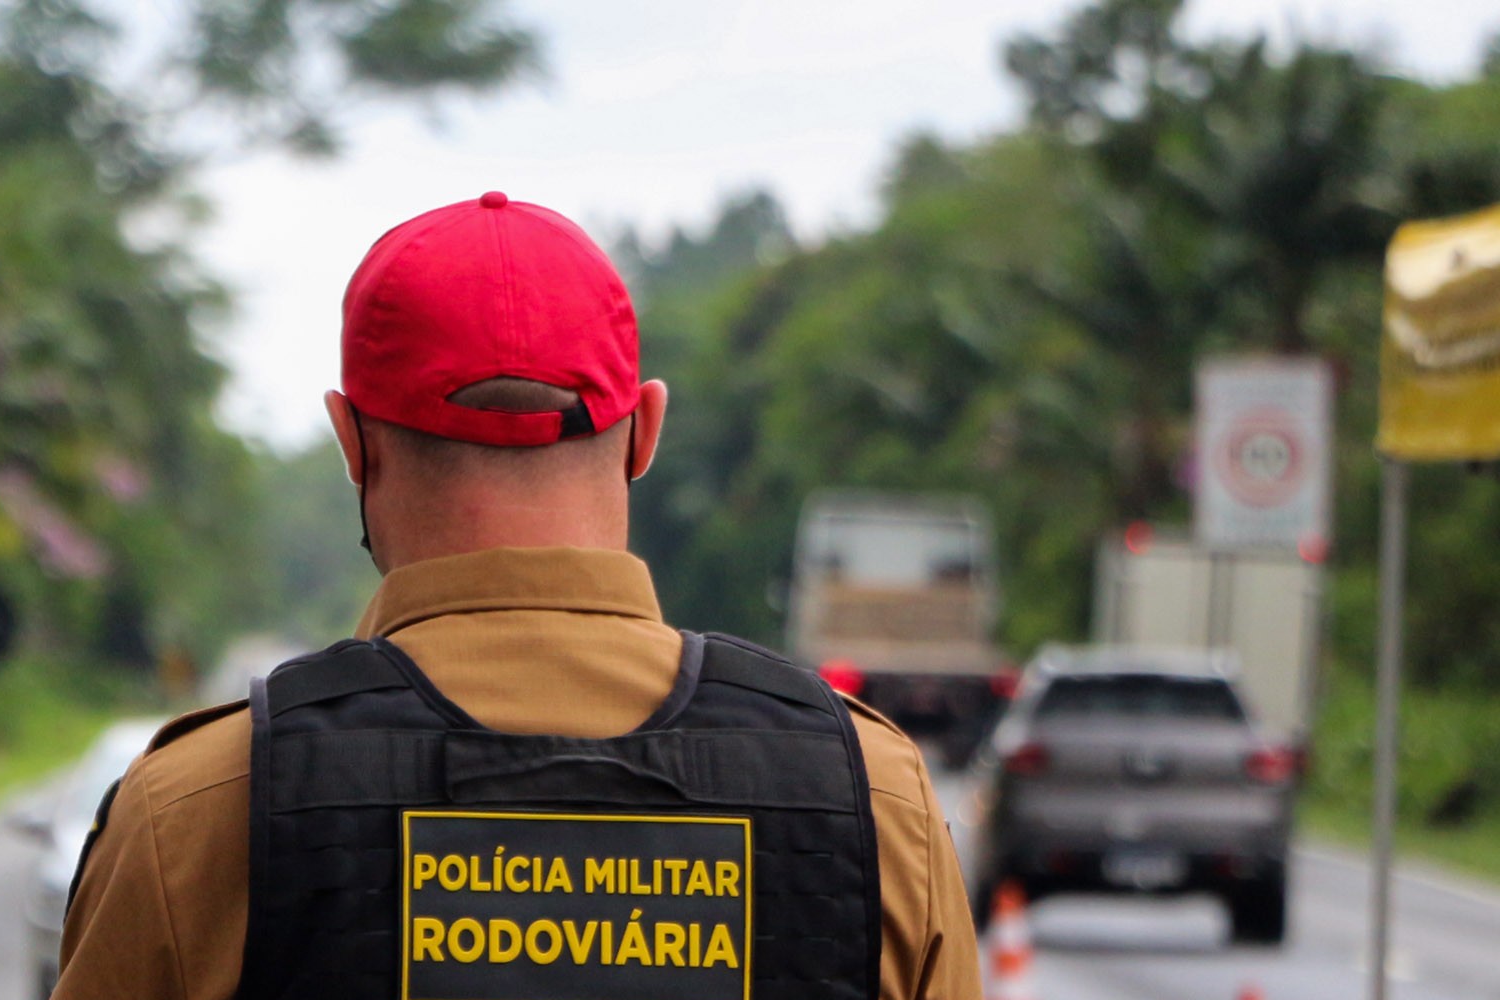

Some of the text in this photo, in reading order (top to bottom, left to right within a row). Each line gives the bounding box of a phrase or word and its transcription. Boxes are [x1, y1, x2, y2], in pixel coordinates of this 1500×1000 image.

[413, 846, 740, 896] POLÍCIA MILITAR
[413, 908, 739, 968] RODOVIÁRIA
